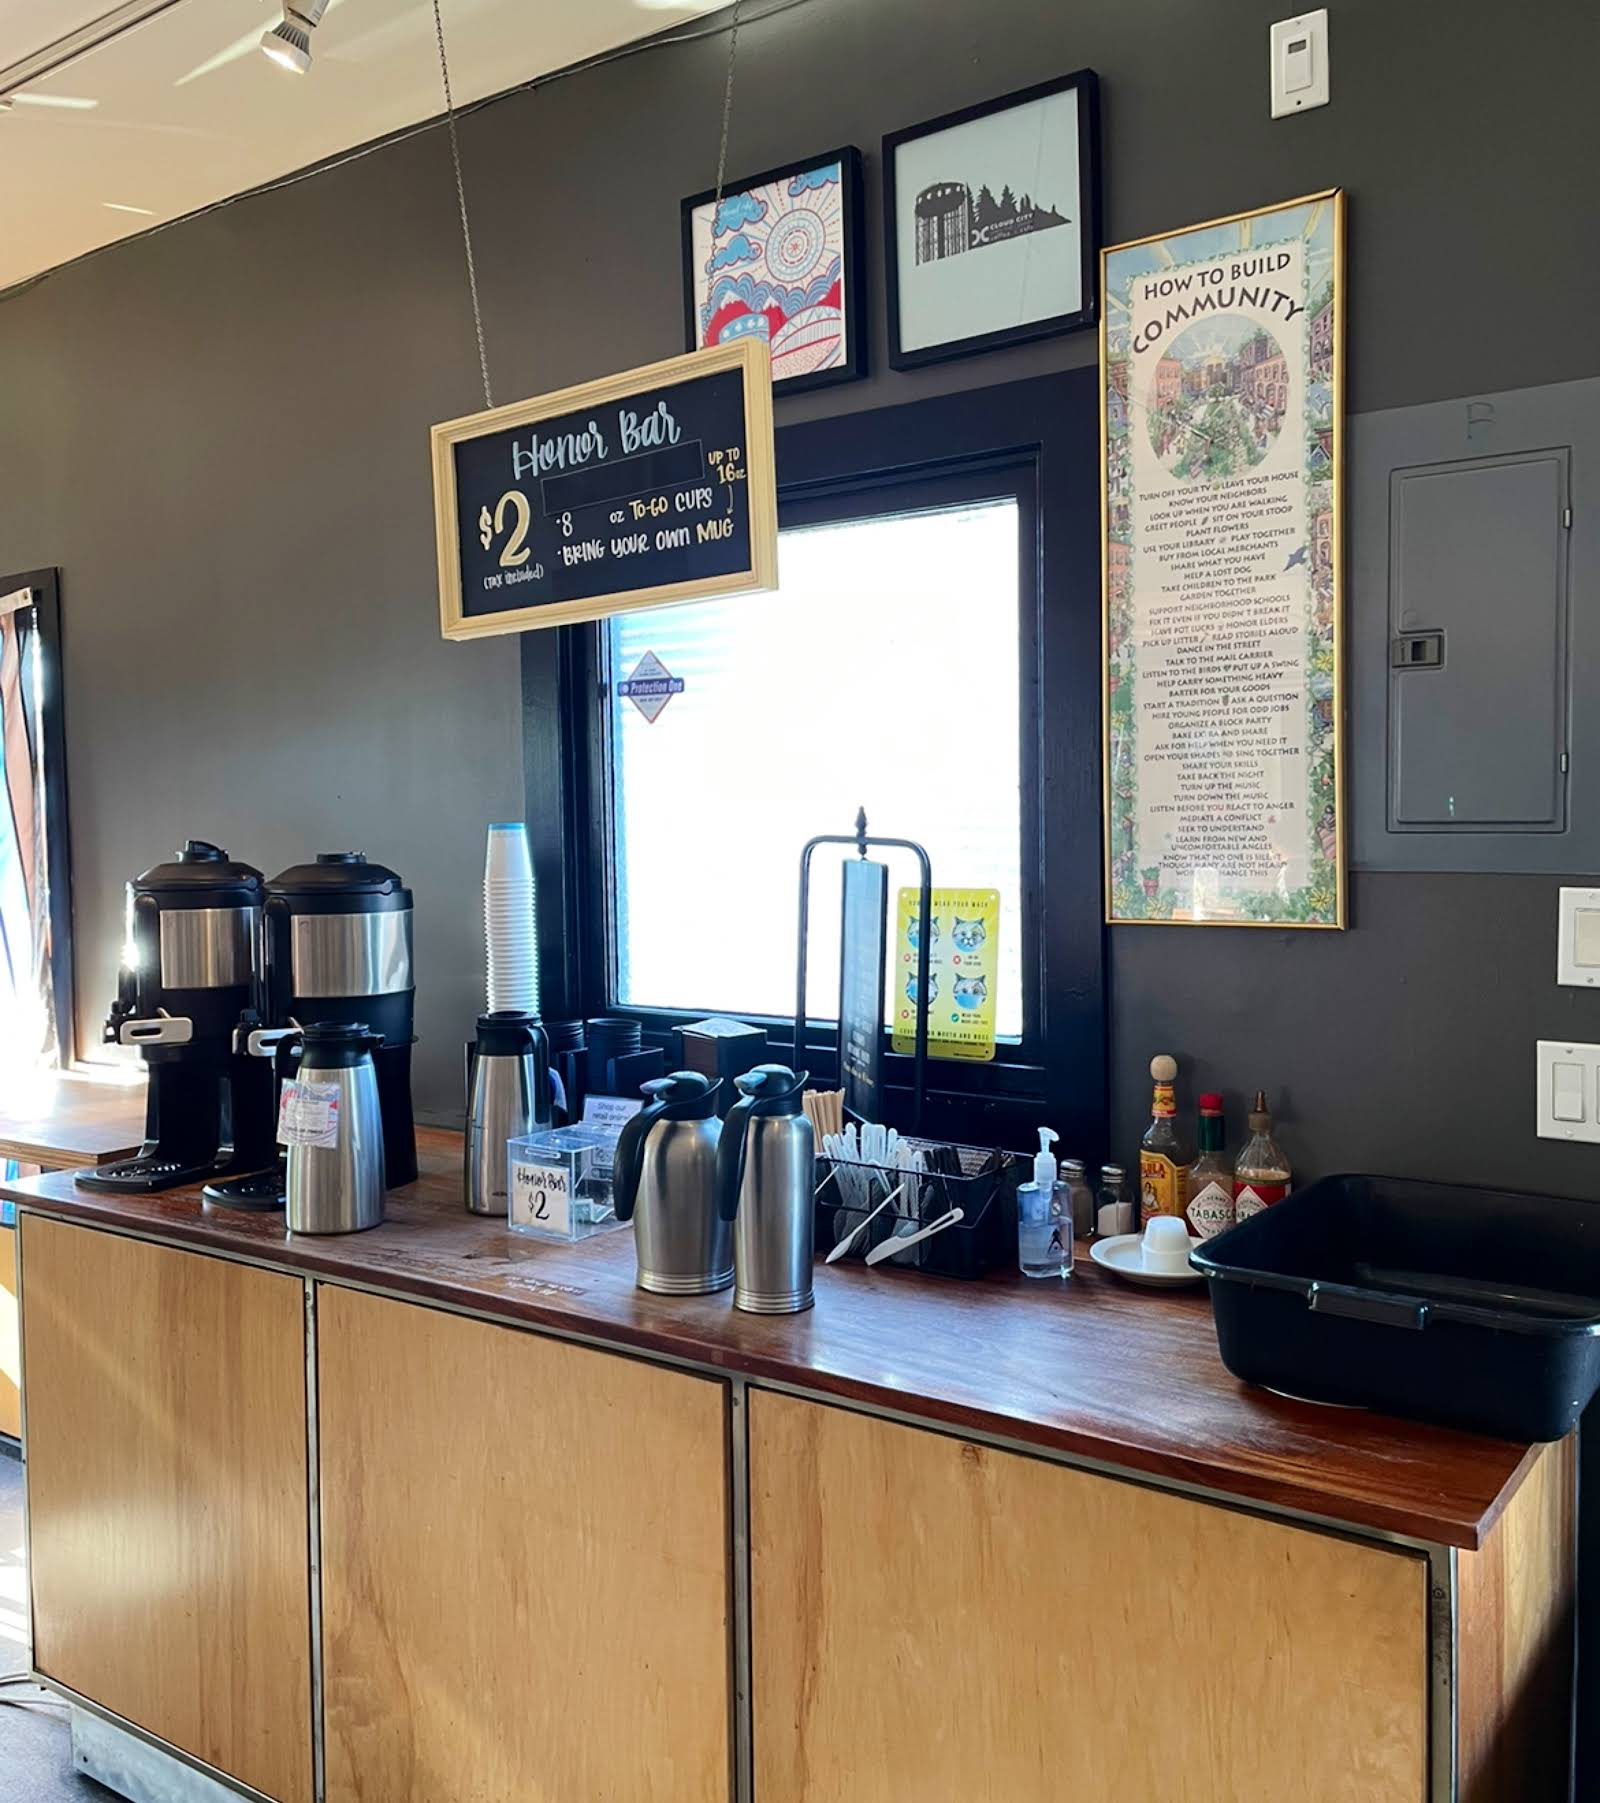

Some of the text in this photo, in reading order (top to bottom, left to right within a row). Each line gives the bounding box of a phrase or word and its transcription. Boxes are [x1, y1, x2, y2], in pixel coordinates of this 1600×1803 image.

[1016, 213, 1033, 222] CITY
[1144, 253, 1291, 300] HOW TO BUILD
[1133, 286, 1304, 354] COMMUNITY
[512, 401, 681, 480] Honor Bar
[708, 447, 740, 466] UP TO
[1139, 470, 1298, 501] TURN OFF YOUR TV LEAVE YOUR HOUSE
[1169, 486, 1266, 507] KNOW YOUR NEIGHBORS
[609, 511, 625, 525] oz
[629, 498, 669, 521] TO-GO
[675, 487, 712, 512] CUPS
[1150, 494, 1287, 521] LOOK UP WHEN YOU ARE WALKING
[1144, 504, 1292, 532] GREET PEOPLE SIT ON YOUR STOOP
[478, 490, 532, 567] $2
[1186, 522, 1248, 537] PLANT FLOWERS
[563, 539, 605, 566] BRING
[611, 534, 650, 558] YOUR
[696, 518, 734, 544] MUG
[1143, 526, 1295, 553] USE YOUR LIBRARY PLAY TOGETHER
[1159, 540, 1277, 562] BUY FROM LOCAL MERCHANTS
[1170, 552, 1264, 571] SHARE WHAT YOU HAVE
[1184, 571, 1202, 580] HELP
[1213, 567, 1231, 576] LOST
[1233, 565, 1251, 574] DOG
[1161, 573, 1275, 593] TAKE CHILDREN TO THE PARK
[1180, 586, 1255, 601] GARDEN TOGETHER
[1177, 639, 1261, 654] DANCE IN THE STREET
[1166, 650, 1272, 666] TALK TO THE MAIL CARRIER
[1142, 669, 1166, 678] LISTEN
[1169, 668, 1179, 676] TO
[1181, 666, 1196, 675] THE
[1198, 665, 1220, 674] BIRDS
[1233, 662, 1248, 671] PUT
[1250, 662, 1261, 670] UP
[1271, 659, 1298, 668] SWING
[630, 680, 667, 694] Protection
[1156, 671, 1283, 687] HELP CARRY SOMETHING HEAVY
[1169, 683, 1269, 697] BARTER FOR YOUR GOODS
[1143, 701, 1165, 710] START
[1176, 698, 1218, 707] TRADITION
[1231, 696, 1247, 704] ASK
[1256, 692, 1298, 702] QUESTION
[1152, 704, 1288, 720] HIRE YOUNG PEOPLE FOR ODD JOBS
[1168, 719, 1208, 729] ORGANIZE
[1219, 717, 1242, 726] BLOCK
[1245, 715, 1271, 724] PARTY
[1144, 753, 1164, 761] OPEN
[1166, 752, 1188, 760] YOUR
[1256, 747, 1299, 756] TOGETHER
[1177, 770, 1263, 780] TAKE BACK THE NIGHT
[1150, 801, 1294, 812] LISTEN BEFORE YOU REACT TO ANGER
[1180, 814, 1214, 822] MEDIATE
[1223, 813, 1261, 821] CONFLICT
[1197, 824, 1207, 832] TO
[1210, 823, 1264, 832] UNDERSTAND
[1176, 835, 1200, 843] LEARN
[1227, 834, 1245, 842] NEW
[1248, 834, 1266, 842] AND
[597, 1102, 614, 1111] Shop
[517, 1168, 566, 1192] Honor Bar
[528, 1190, 550, 1220] $2
